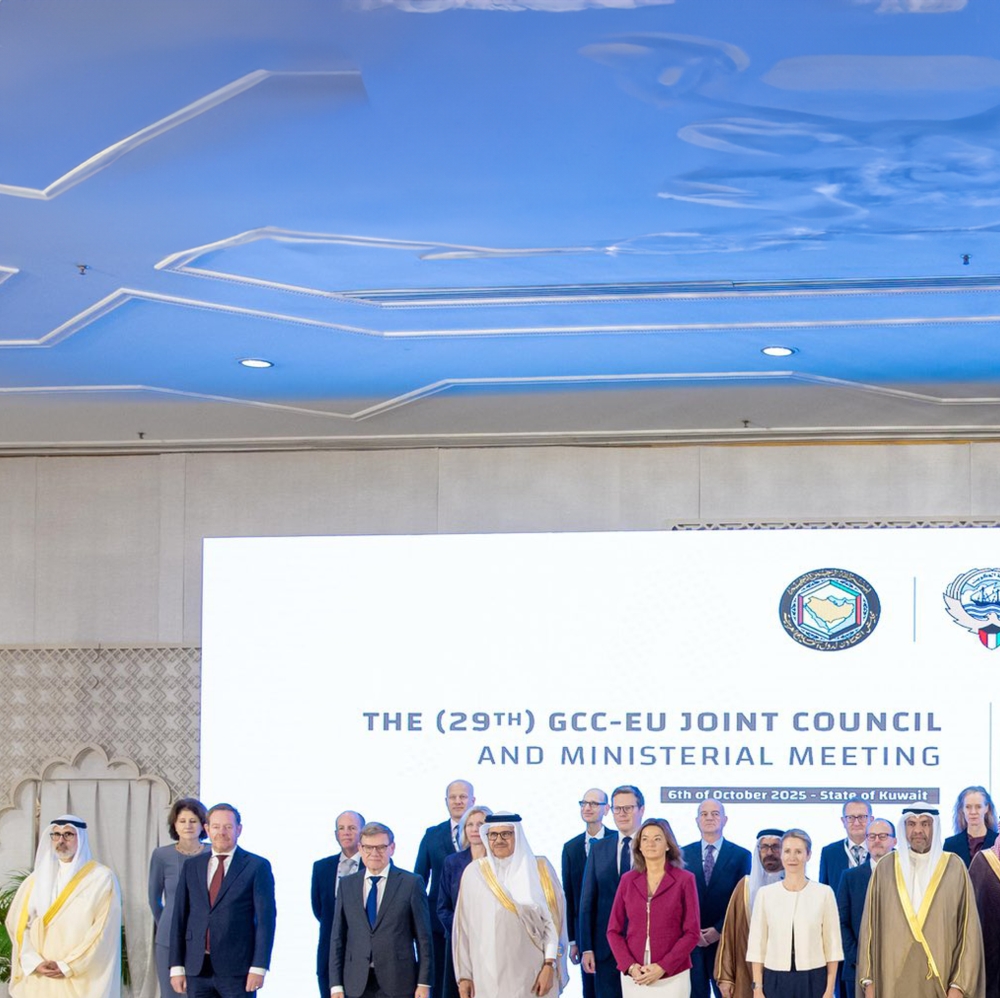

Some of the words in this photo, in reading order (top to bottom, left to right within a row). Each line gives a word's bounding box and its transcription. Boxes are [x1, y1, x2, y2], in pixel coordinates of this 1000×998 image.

[362, 712, 423, 732] THE
[436, 710, 535, 735] (29TH)
[548, 712, 666, 732] GCC-EU
[680, 712, 779, 732] JOINT
[792, 711, 942, 732] COUNCIL
[477, 746, 544, 766] AND
[561, 746, 774, 766] MINISTERIAL
[788, 746, 940, 767] MEETING
[667, 790, 692, 800] 6th
[695, 790, 710, 800] of
[713, 790, 767, 800] October
[771, 790, 807, 800] 2025
[820, 790, 857, 800] State
[860, 790, 876, 800] of
[879, 789, 928, 801] Kuwait
